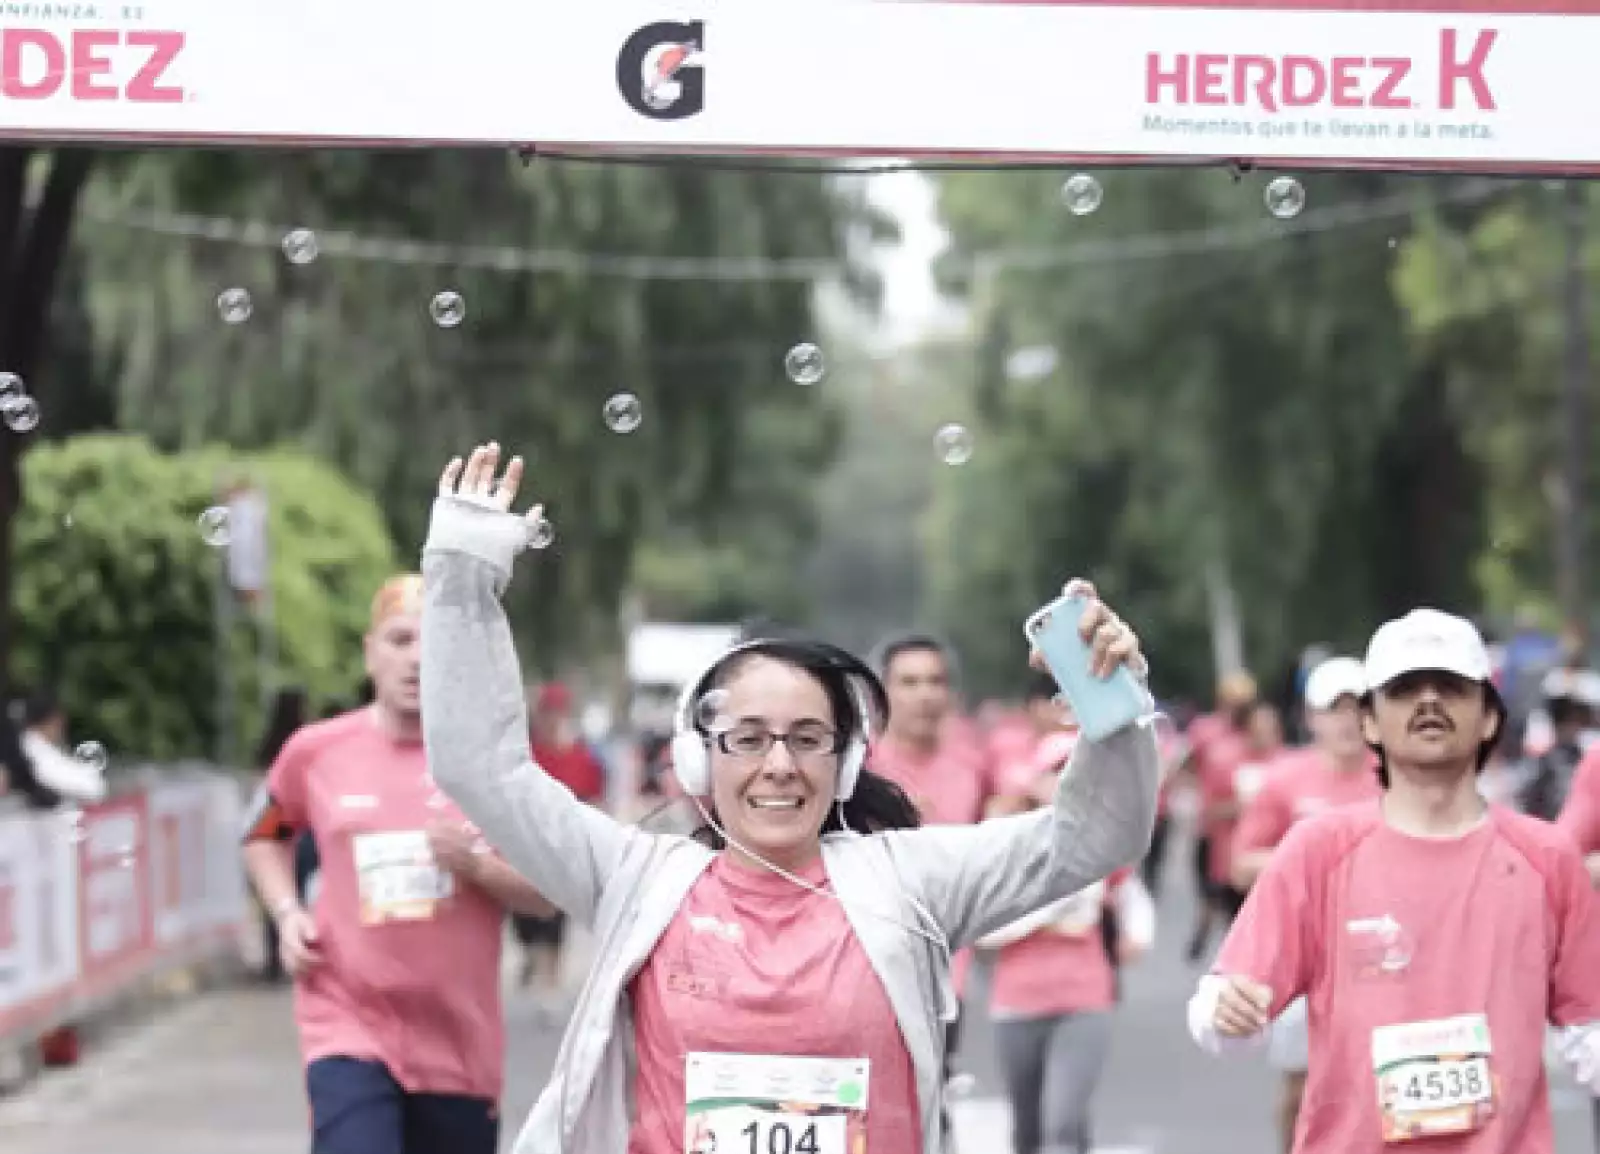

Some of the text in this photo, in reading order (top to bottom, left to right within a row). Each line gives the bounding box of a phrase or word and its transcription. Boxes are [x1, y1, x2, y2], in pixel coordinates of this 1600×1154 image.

[616, 20, 706, 120] G
[1146, 28, 1498, 112] HERDEZ K
[1143, 115, 1253, 136] Momentos
[1257, 121, 1297, 139] que
[1303, 118, 1323, 137] te
[1329, 118, 1389, 138] llevan
[1398, 123, 1408, 139] a
[1414, 118, 1431, 139] la
[1404, 1065, 1481, 1101] 4538
